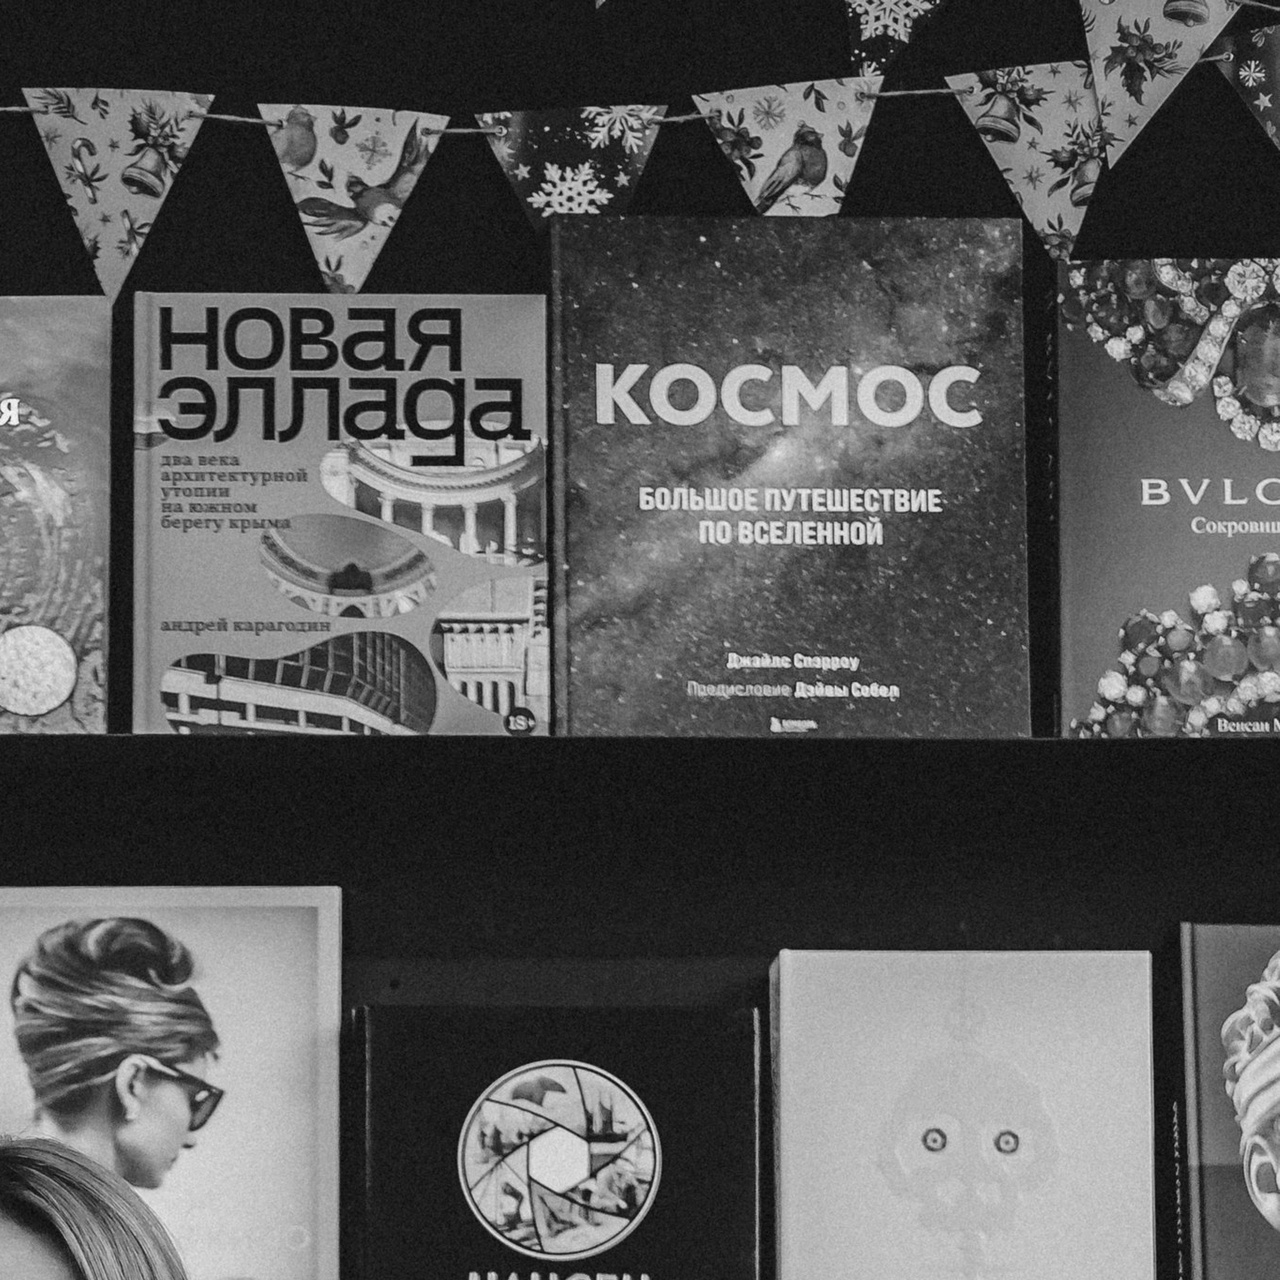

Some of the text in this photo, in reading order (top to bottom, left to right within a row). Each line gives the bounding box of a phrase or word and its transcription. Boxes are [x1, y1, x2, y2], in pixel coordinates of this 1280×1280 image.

[595, 362, 984, 428] КОСМОС
[161, 455, 240, 468] два века
[160, 467, 308, 485] архитектурной
[161, 487, 230, 501] утопии
[639, 486, 943, 513] БОЛЬШОЕ ПУТЕШЕСТВИЕ
[1140, 477, 1280, 507] BVLG
[161, 502, 257, 514] на южном
[160, 515, 292, 532] берегу крыма
[698, 516, 884, 545] ПО ВСЕЛЕННОЙ
[160, 618, 332, 636] андрей карагодин
